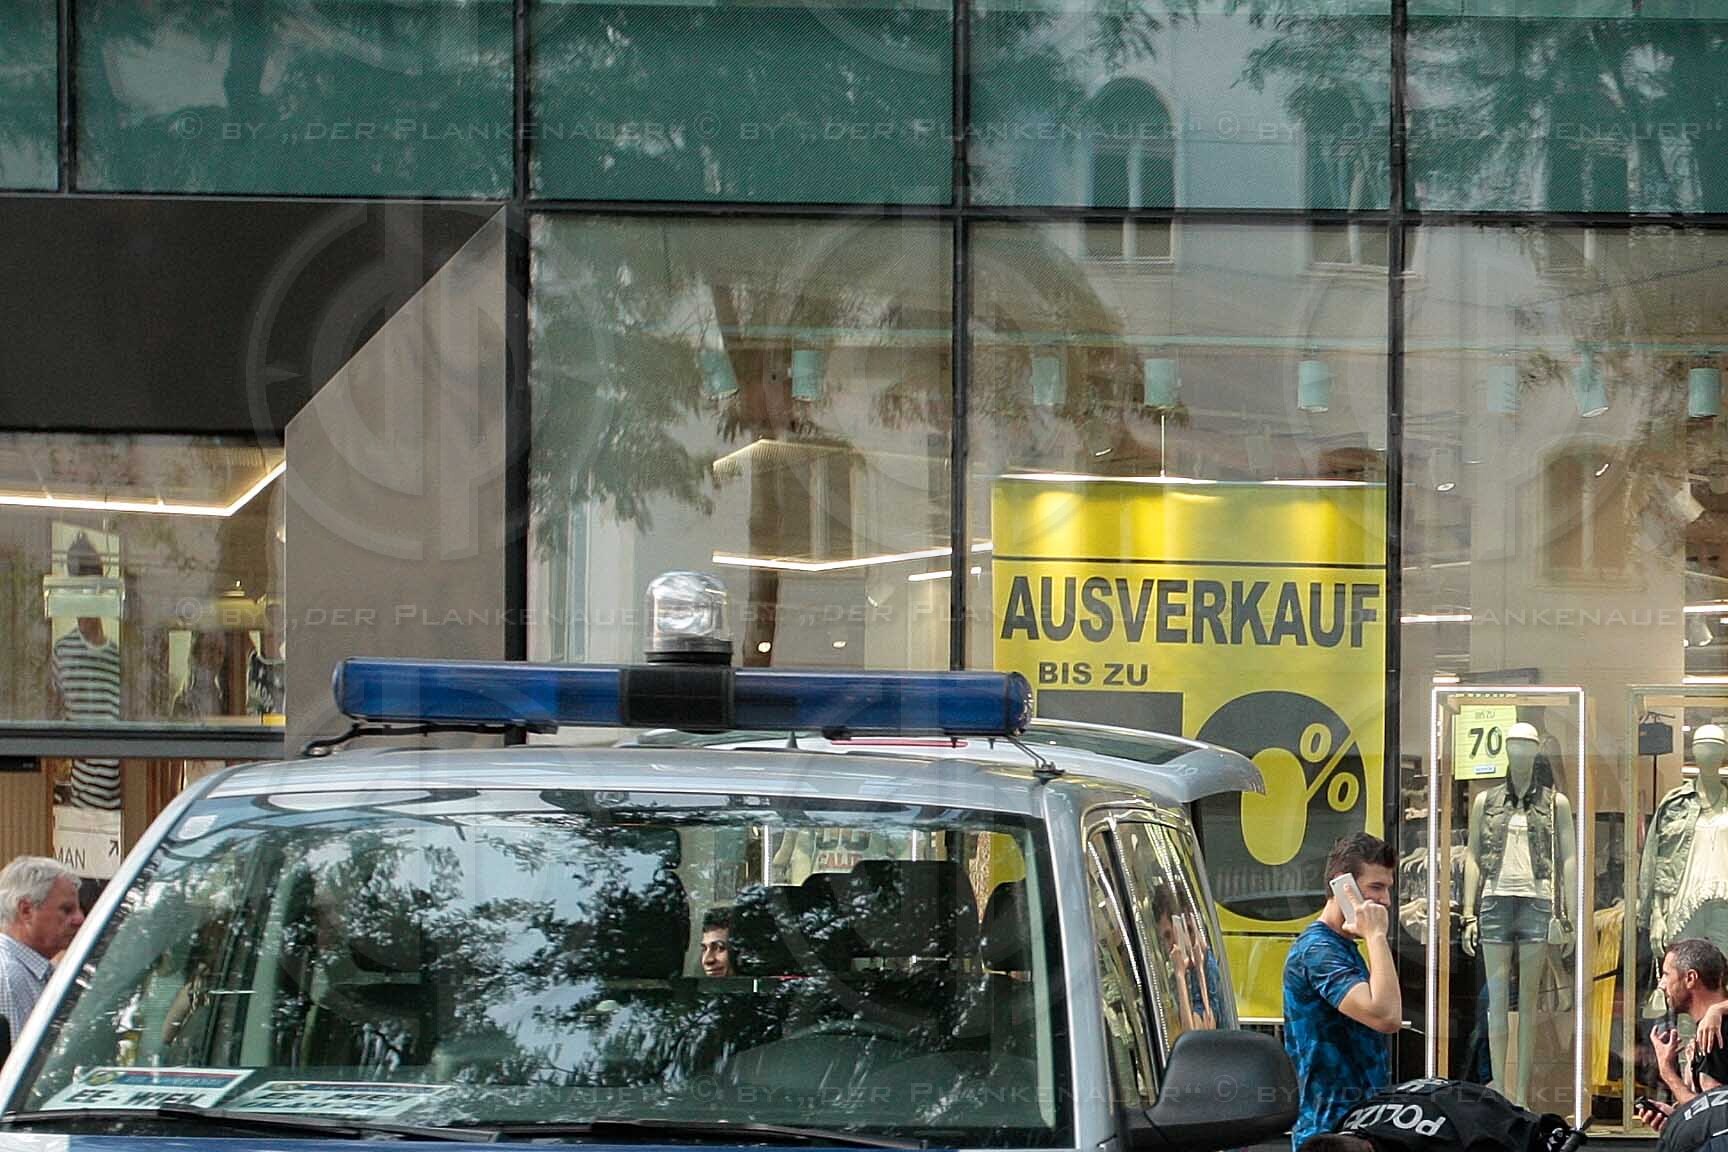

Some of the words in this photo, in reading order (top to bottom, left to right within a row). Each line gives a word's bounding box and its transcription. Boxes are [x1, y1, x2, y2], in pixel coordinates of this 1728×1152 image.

[1000, 576, 1380, 648] AUSVERKAUF
[1038, 661, 1092, 685] BIS
[1103, 662, 1149, 687] ZU
[1469, 726, 1503, 757] 70
[64, 1089, 114, 1103] EE
[1343, 1103, 1447, 1136] POLIZ
